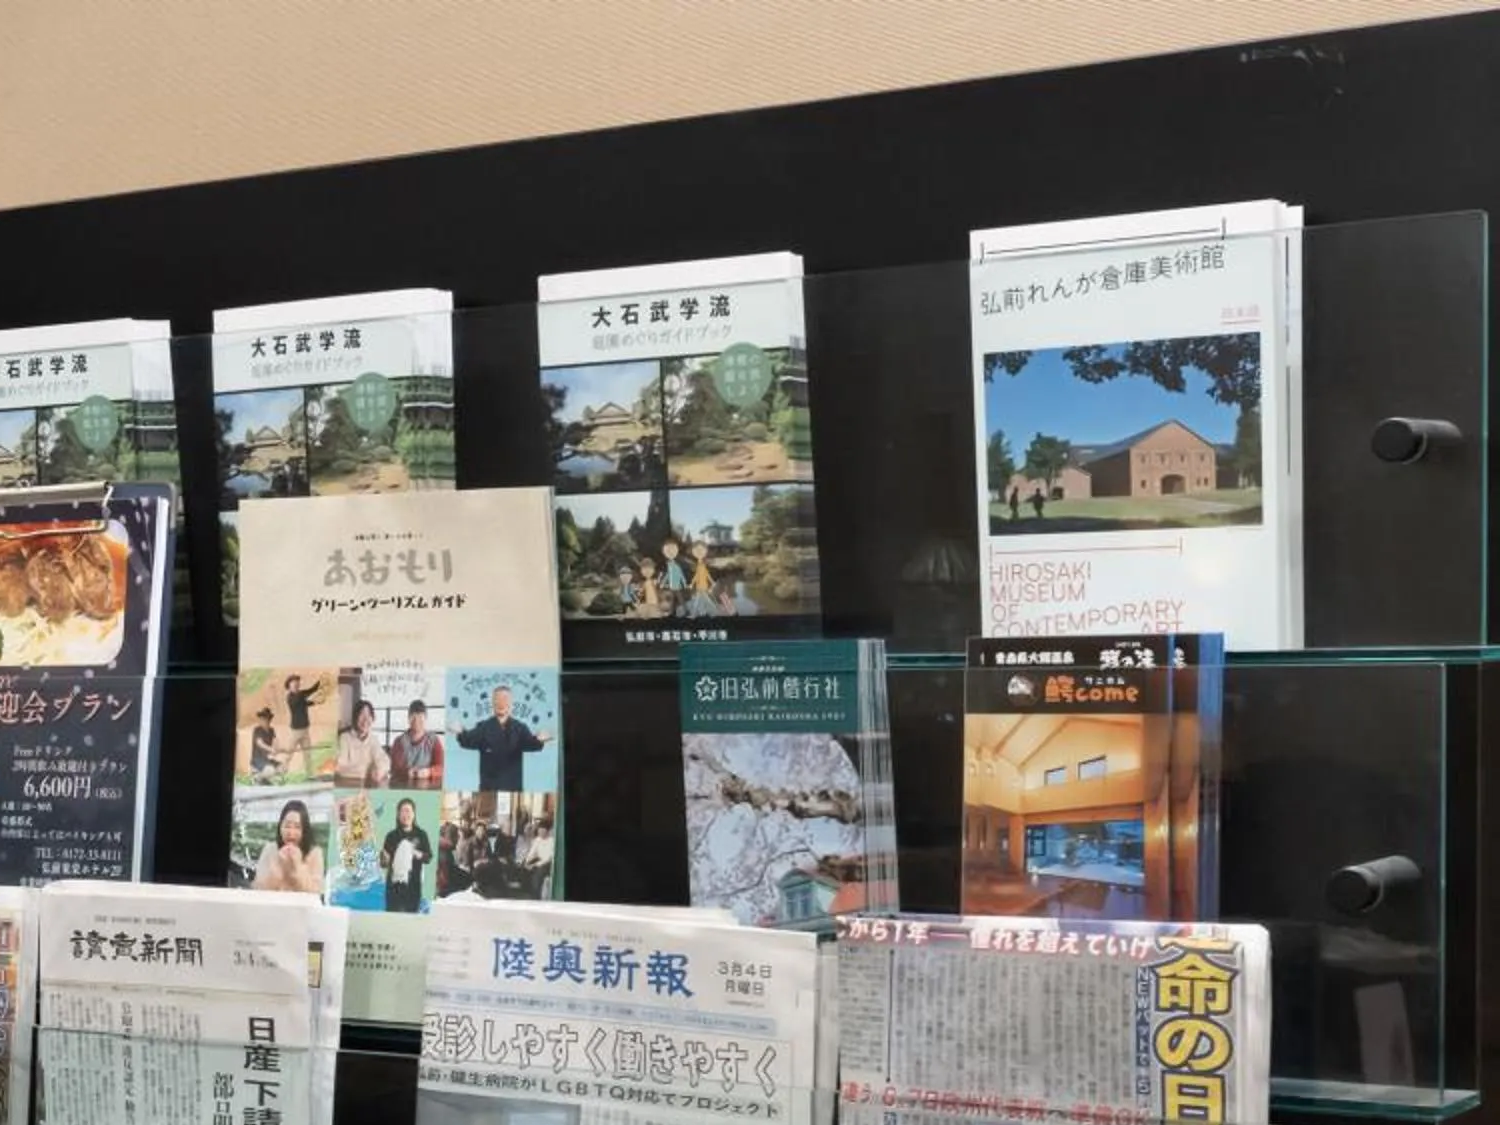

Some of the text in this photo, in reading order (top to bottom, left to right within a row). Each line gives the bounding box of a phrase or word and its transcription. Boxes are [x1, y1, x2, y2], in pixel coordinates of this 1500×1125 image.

[980, 243, 1226, 318] 弘前れんが倉庫美術館
[591, 295, 732, 330] 大石武学流
[251, 327, 362, 359] 大石武学流
[323, 547, 453, 588] あおもり
[989, 560, 1092, 583] HIROSAKI
[990, 582, 1085, 602] MUSEUM
[991, 603, 1020, 624] OF
[991, 600, 1186, 637] CONTEMPORARY
[721, 676, 841, 700] 旧弘前偕行社
[23, 775, 92, 799] 6,600円
[492, 937, 693, 998] 陸奥新報
[717, 960, 772, 979] 3月4日
[725, 979, 765, 996] 月曜日
